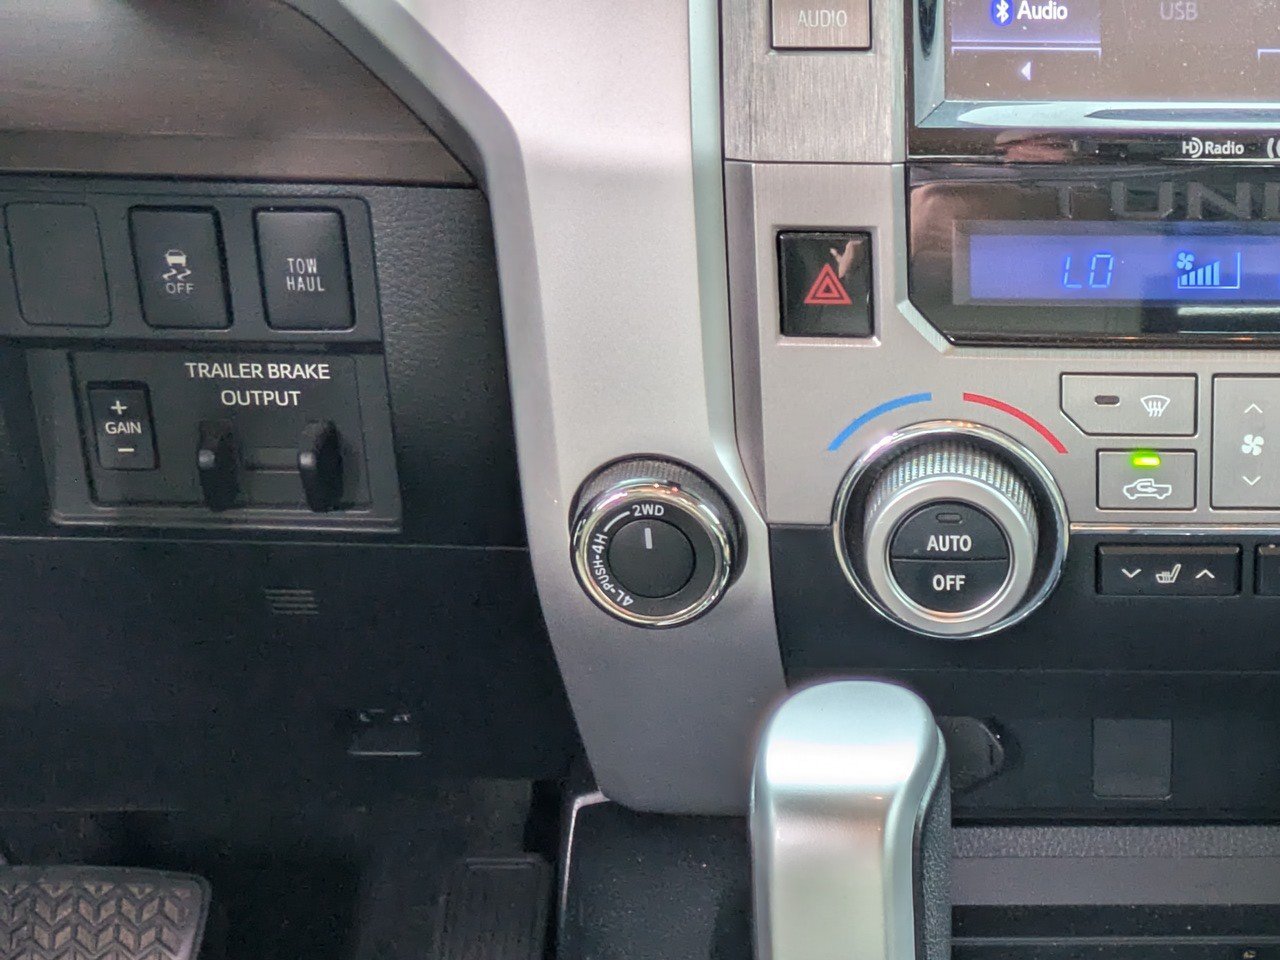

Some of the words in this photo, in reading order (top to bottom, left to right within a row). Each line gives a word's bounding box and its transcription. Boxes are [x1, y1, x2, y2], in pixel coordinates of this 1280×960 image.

[798, 9, 848, 28] AUDIO
[1017, 1, 1068, 20] Audio
[1160, 1, 1198, 20] USB
[1205, 141, 1245, 154] Radio
[287, 258, 317, 274] TOW
[165, 283, 194, 294] OFF
[287, 277, 325, 292] HAUL
[185, 363, 264, 379] TRAILER
[268, 364, 330, 379] BRAKE
[221, 390, 301, 406] OUTPUT
[105, 422, 142, 434] GAIN
[631, 504, 665, 516] 2WD
[927, 535, 972, 552] AUTO
[932, 575, 965, 591] OFF
